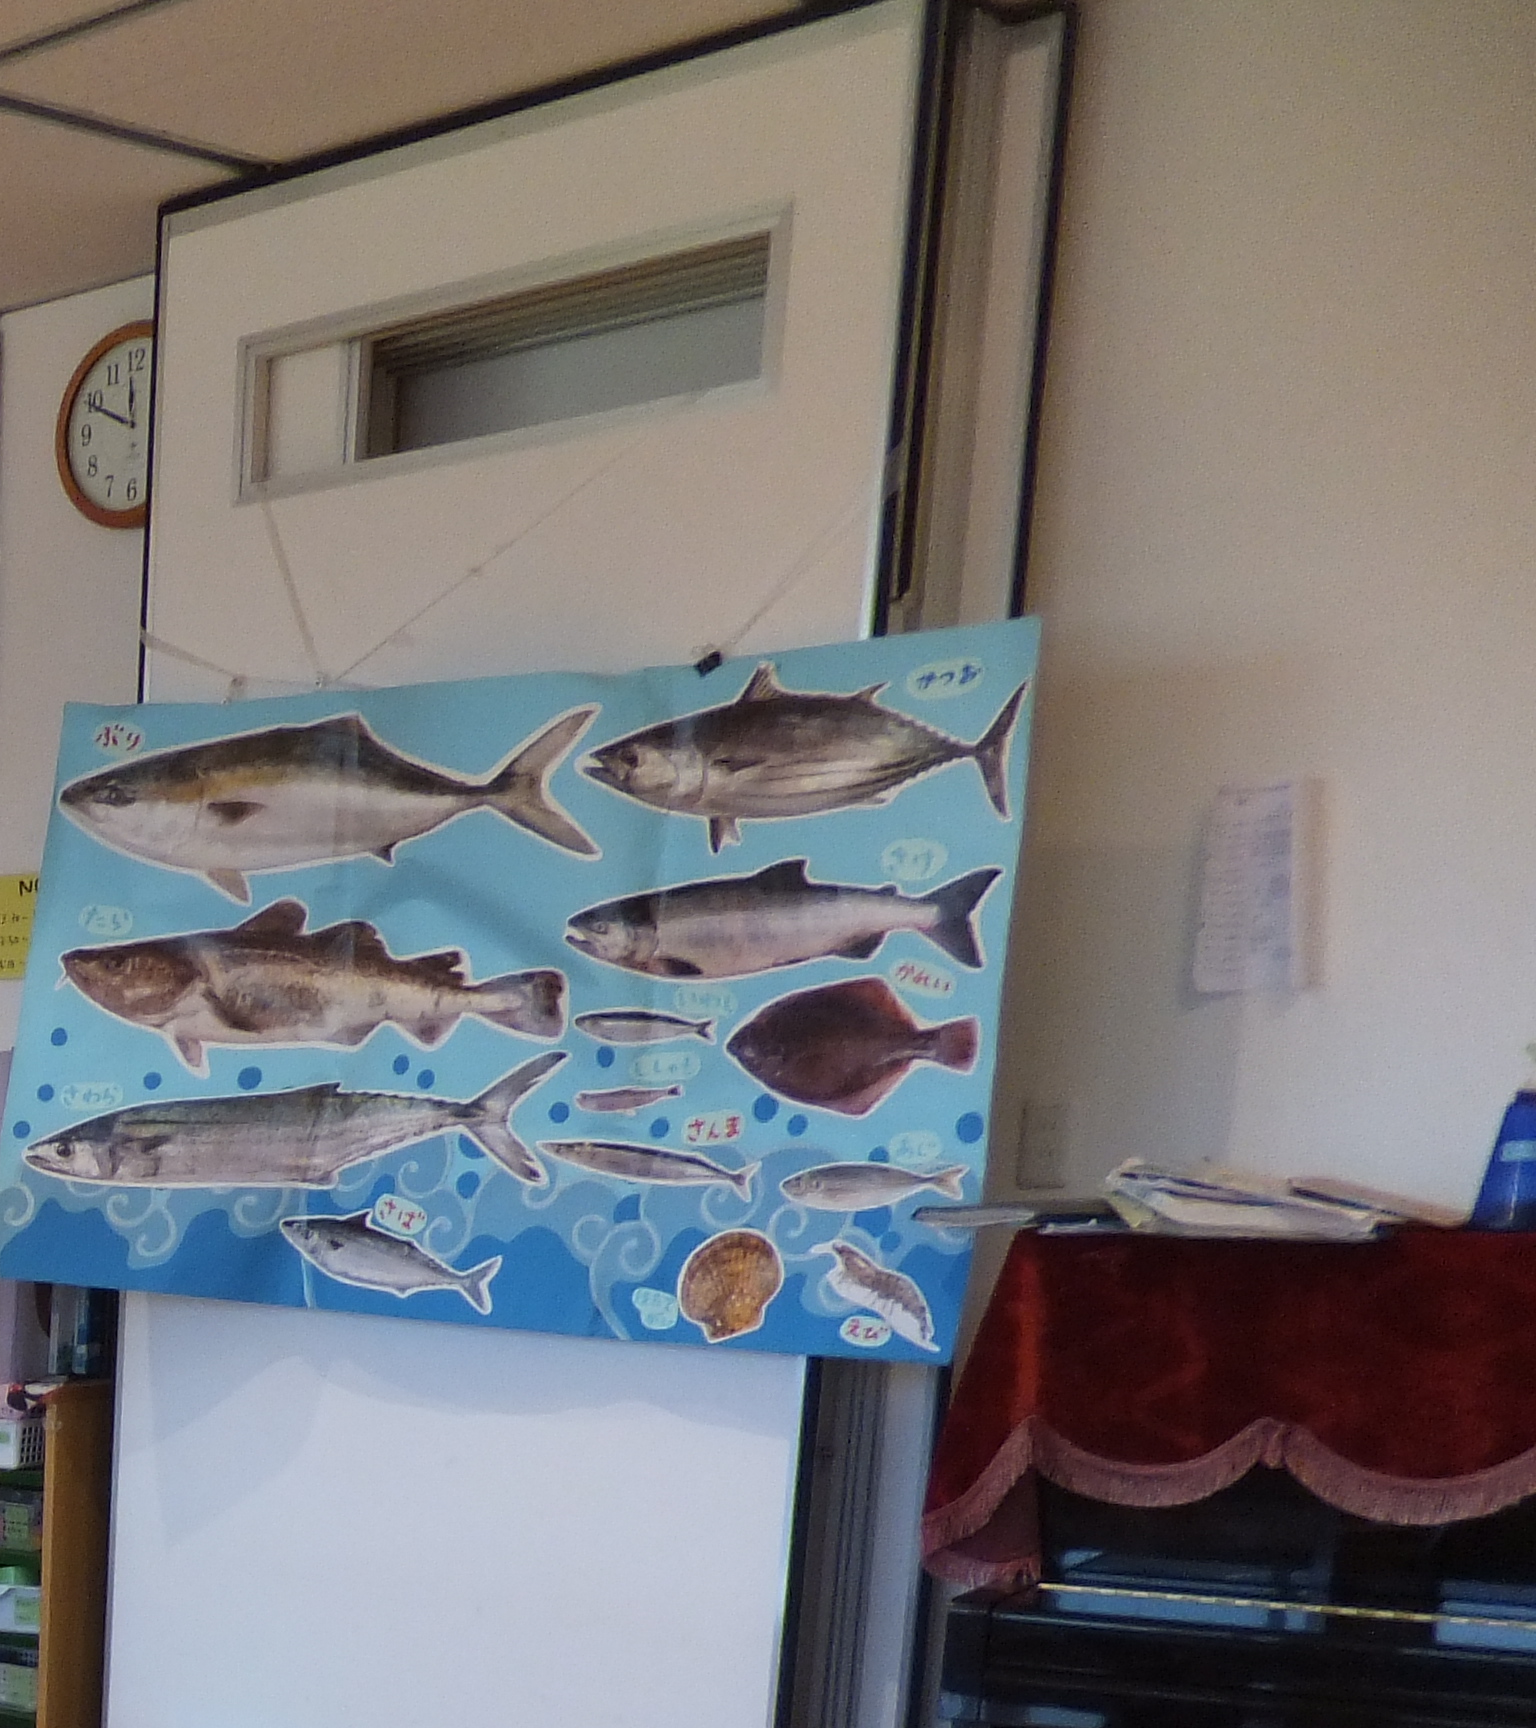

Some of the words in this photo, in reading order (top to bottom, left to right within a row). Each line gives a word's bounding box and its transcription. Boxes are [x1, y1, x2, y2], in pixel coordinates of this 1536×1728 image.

[127, 347, 146, 372] 12
[107, 363, 121, 386] 11
[86, 390, 104, 413] 10
[81, 424, 92, 446] 9
[87, 455, 98, 477] 8
[105, 475, 115, 497] 7
[126, 478, 137, 501] 6
[95, 724, 141, 751] ぶり
[686, 1116, 740, 1140] さんま
[378, 1199, 425, 1230] さば
[847, 1318, 889, 1340] えび
